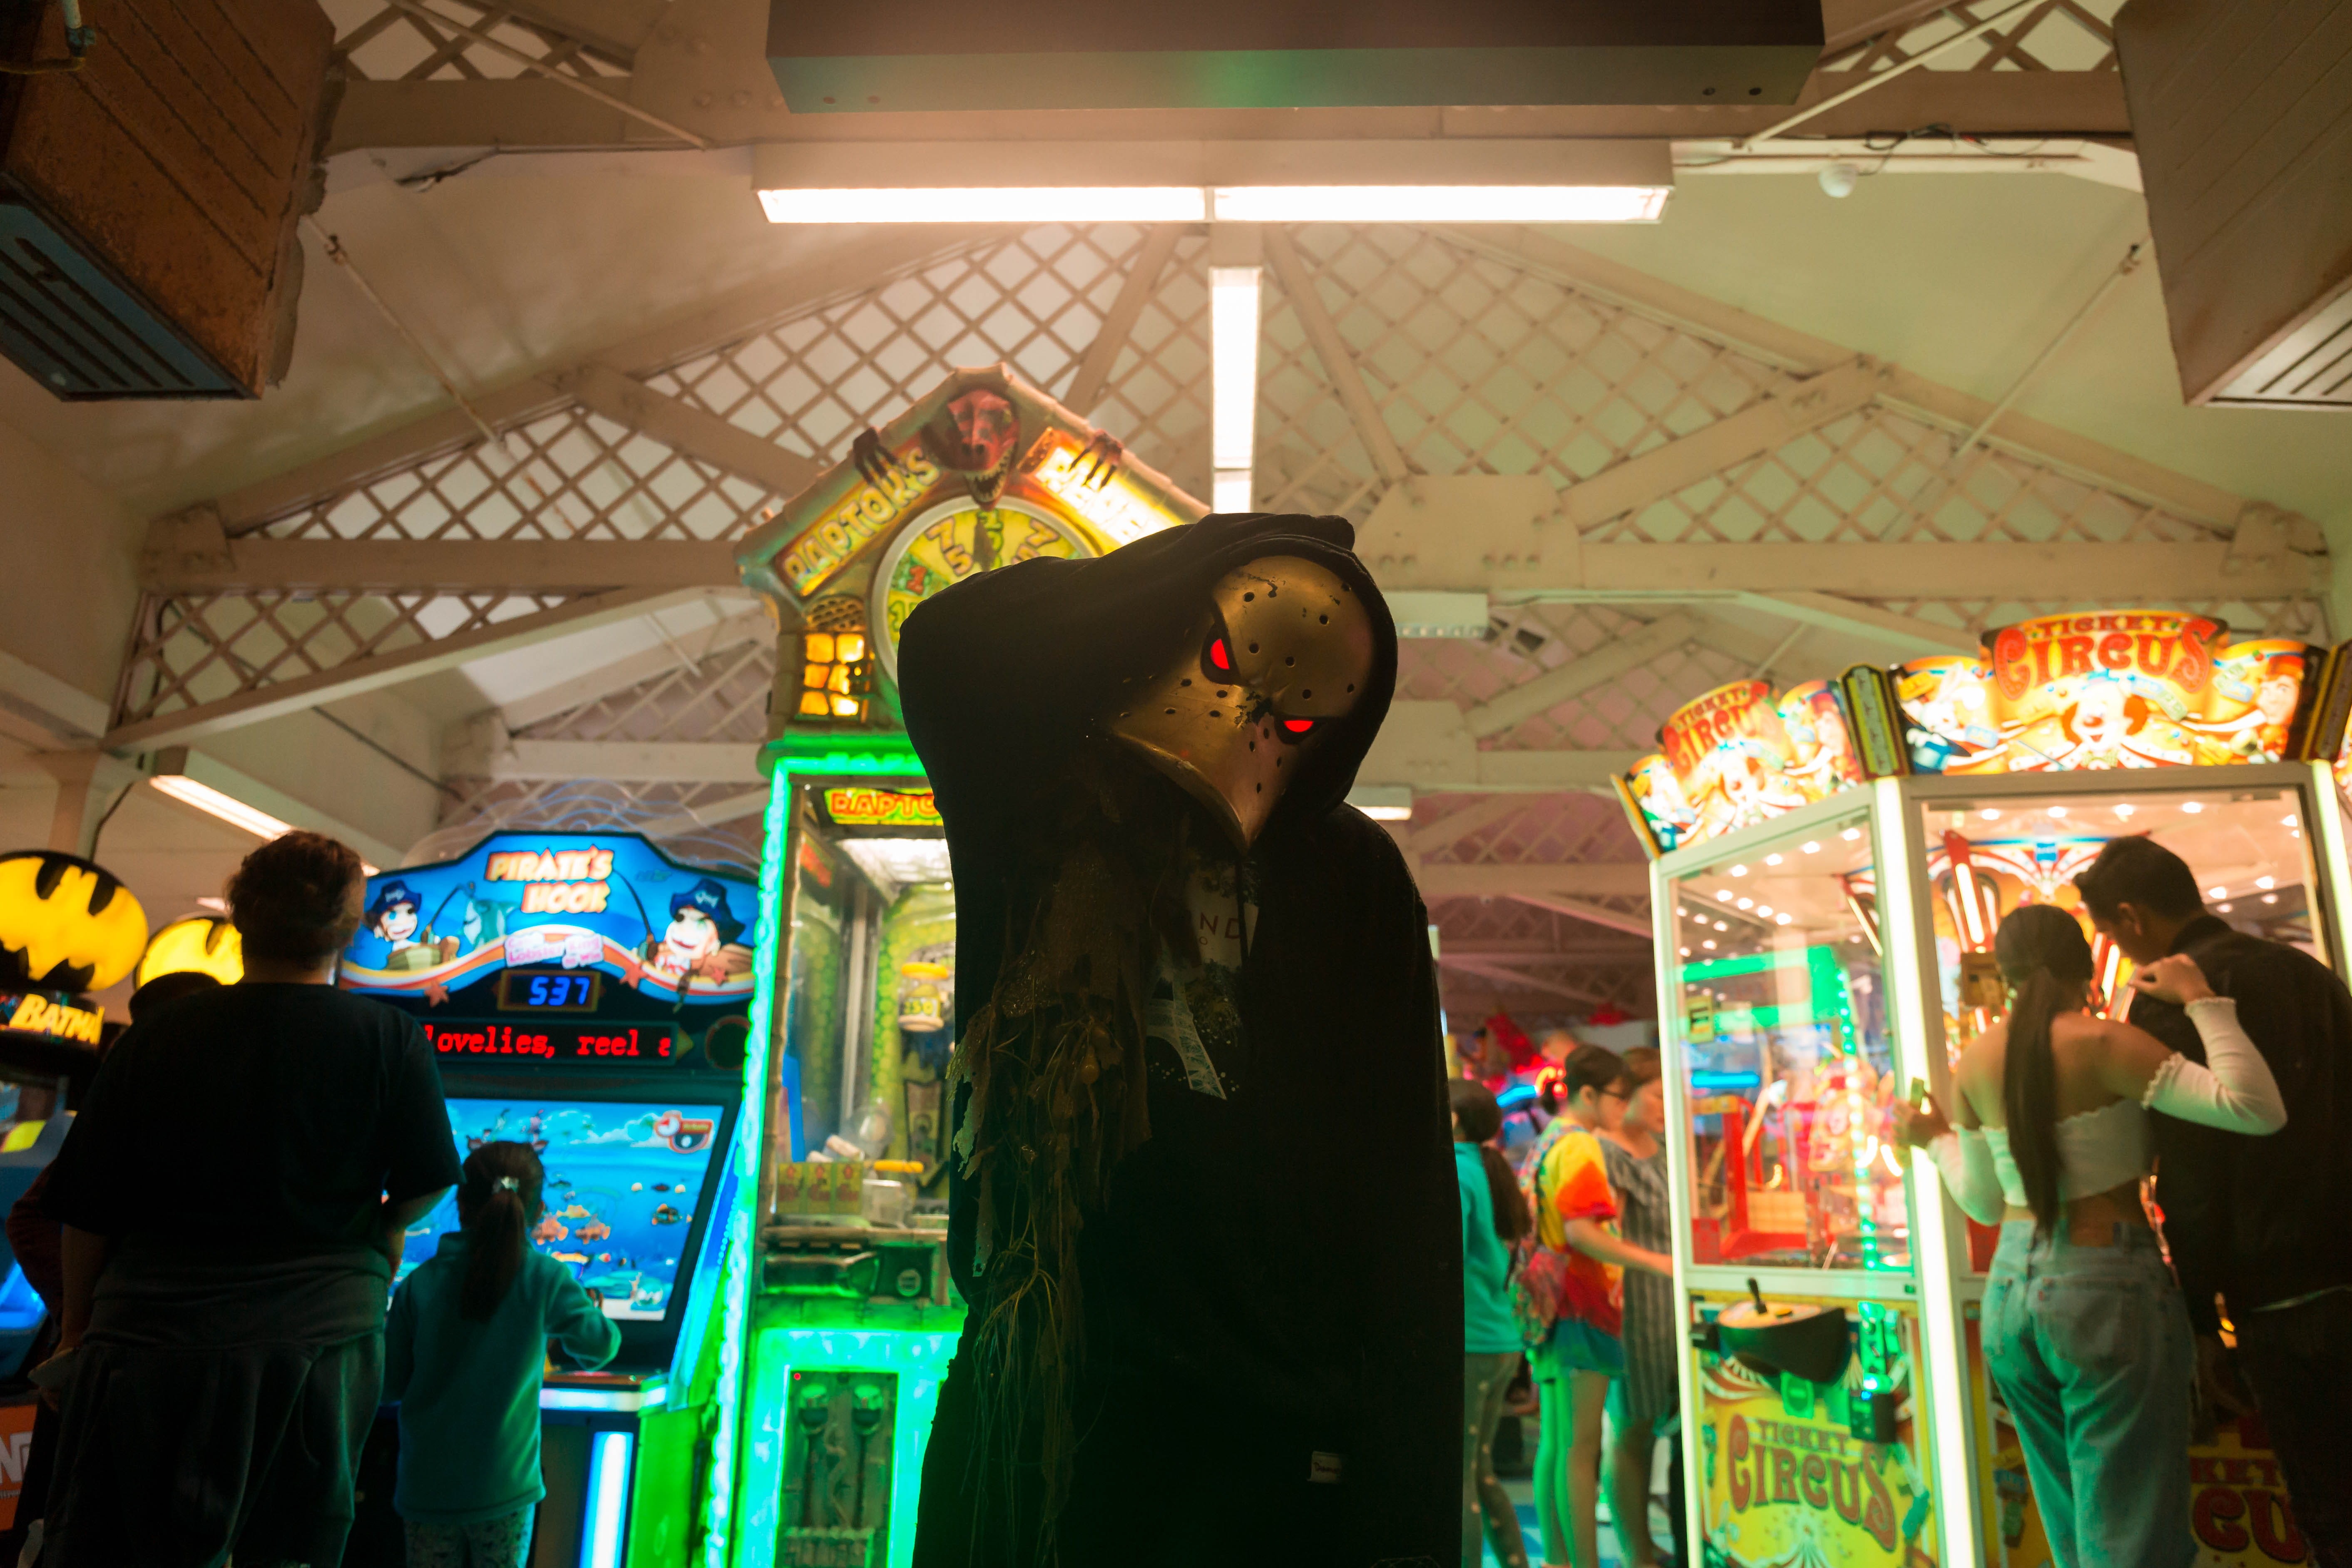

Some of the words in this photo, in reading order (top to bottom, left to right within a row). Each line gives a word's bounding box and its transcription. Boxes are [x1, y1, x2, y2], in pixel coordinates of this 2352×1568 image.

[2036, 615, 2167, 637] TICKET
[1994, 619, 2218, 701] CIRCUS
[831, 791, 940, 818] RAPTO
[485, 845, 614, 882] PIRATE'S
[521, 880, 611, 914] HOOK
[527, 975, 591, 1006] 537
[577, 1029, 640, 1056] reel
[1757, 1419, 1851, 1456] TICKET
[1728, 1414, 1897, 1552] CIRCUS
